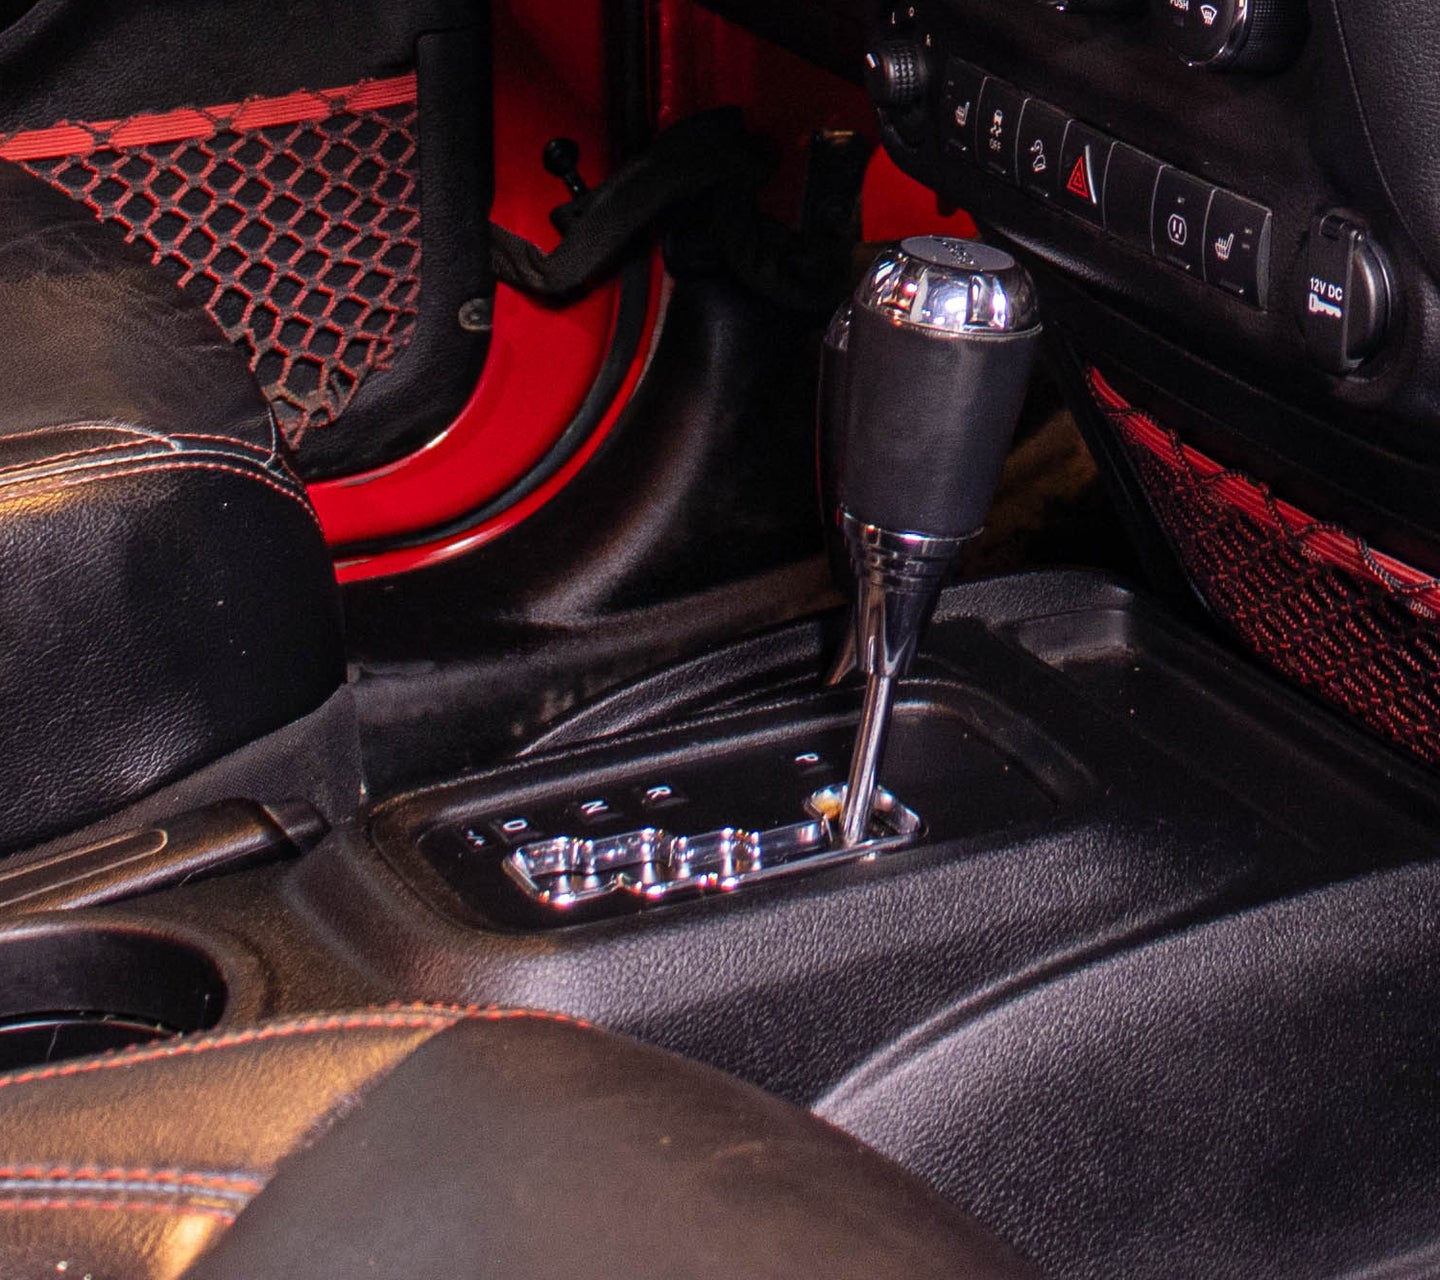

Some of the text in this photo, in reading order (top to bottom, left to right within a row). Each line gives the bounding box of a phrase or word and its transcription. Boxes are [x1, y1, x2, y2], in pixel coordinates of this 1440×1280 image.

[1310, 277, 1344, 302] 12V DC
[794, 752, 821, 765] P
[646, 785, 673, 801] R
[580, 798, 609, 816] N
[502, 818, 528, 832] D
